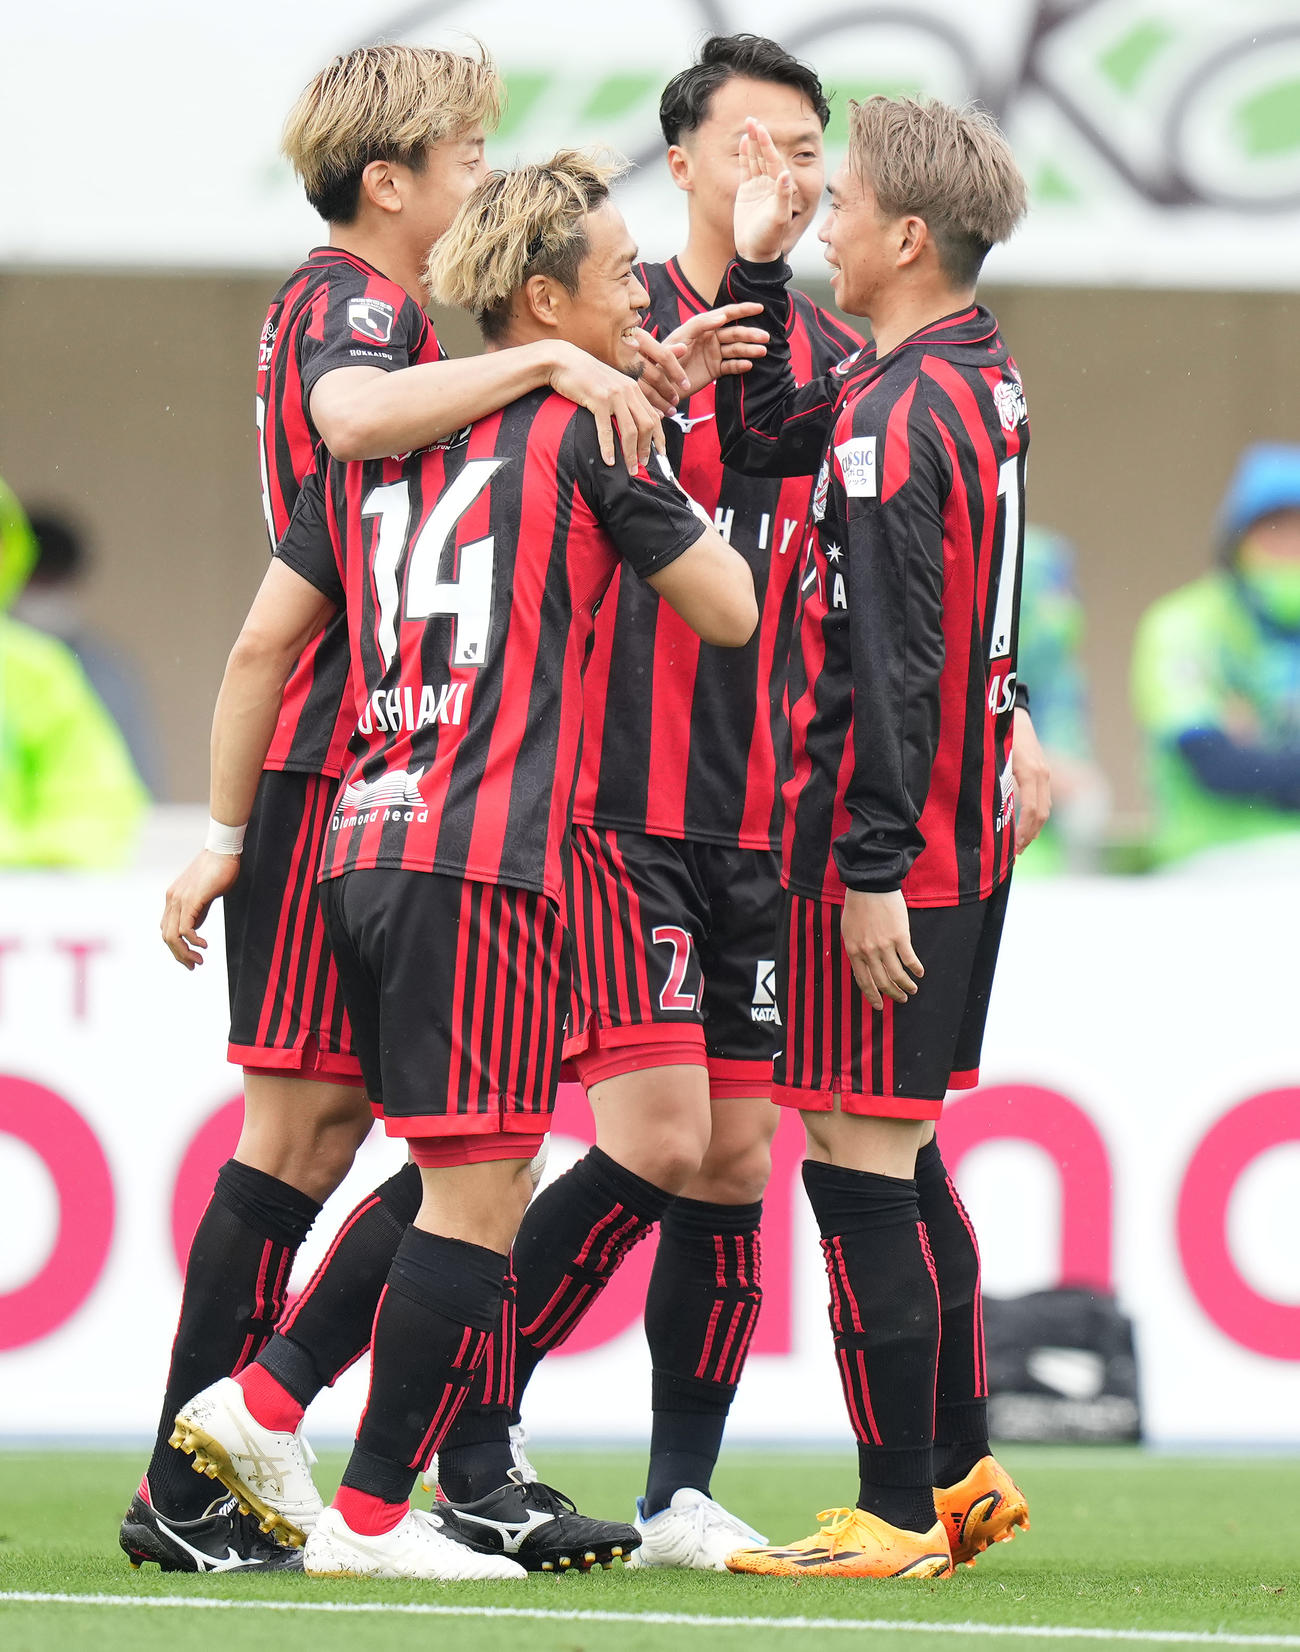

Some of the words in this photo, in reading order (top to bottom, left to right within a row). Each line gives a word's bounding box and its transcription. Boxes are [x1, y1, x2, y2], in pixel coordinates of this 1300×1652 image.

[361, 457, 512, 673] 14
[351, 683, 468, 737] OSHIAKI
[332, 808, 379, 831] Diamond
[382, 808, 429, 823] head
[751, 1007, 777, 1022] KATA
